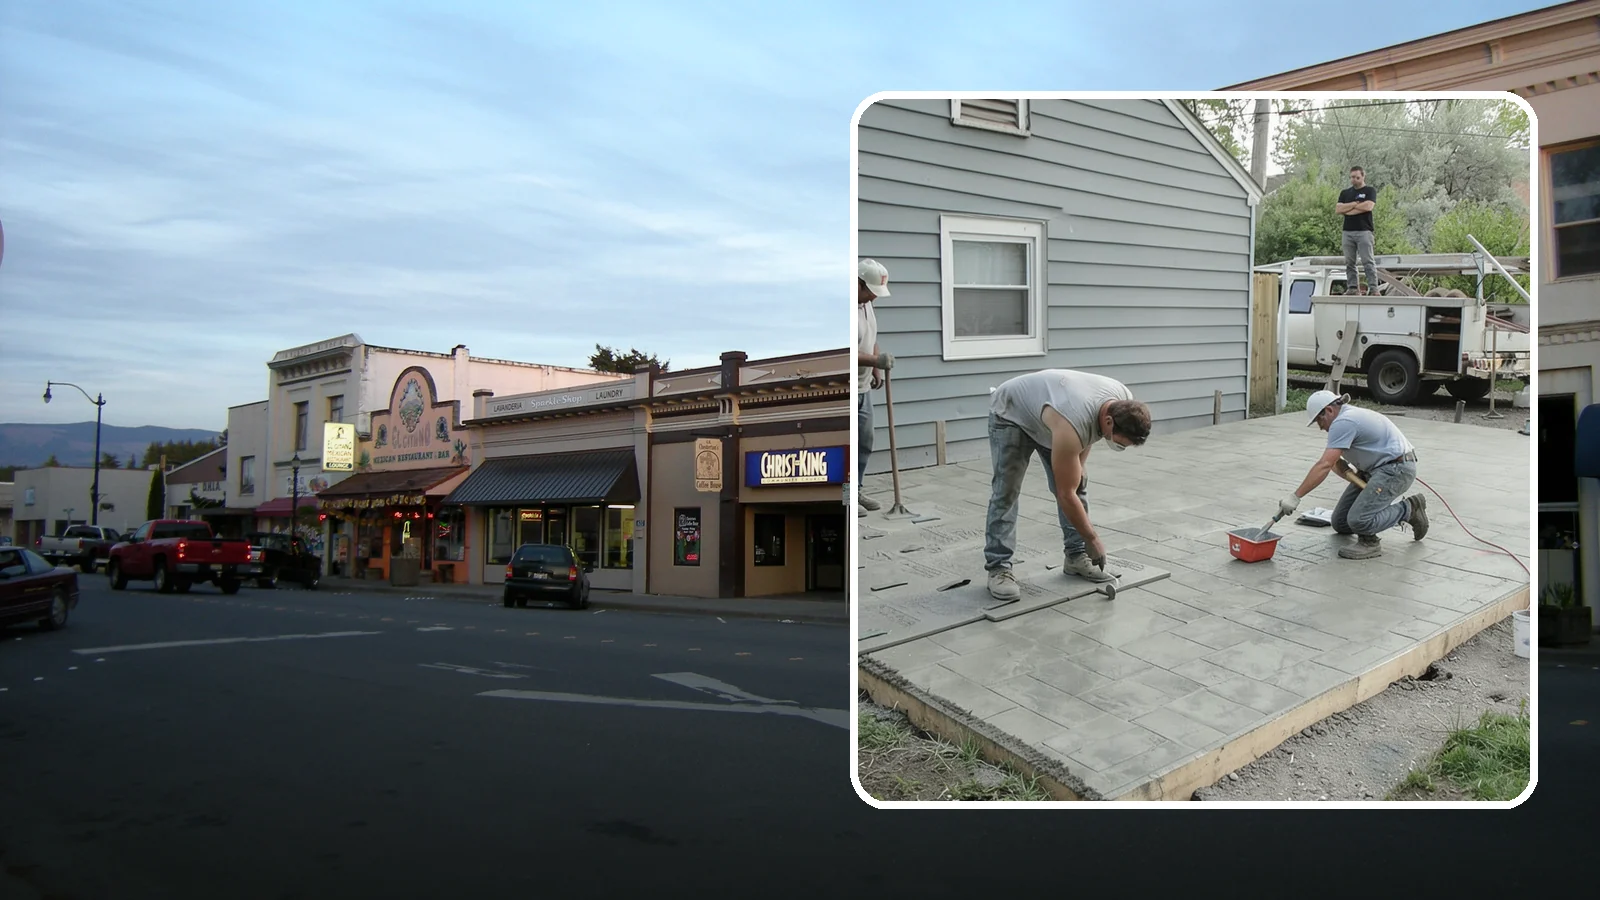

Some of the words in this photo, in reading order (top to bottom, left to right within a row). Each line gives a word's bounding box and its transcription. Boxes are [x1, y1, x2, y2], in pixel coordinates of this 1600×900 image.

[595, 389, 624, 400] LAUNDRY
[493, 402, 523, 413] LAVANDERIA
[530, 398, 561, 409] Sparkle
[562, 394, 582, 405] Shop
[373, 455, 396, 464] MEXICAN
[397, 451, 433, 462] RESTAURANT
[438, 450, 450, 459] BAR
[761, 452, 797, 478] CHRIST
[799, 450, 827, 476] KING
[696, 480, 709, 488] Coffee
